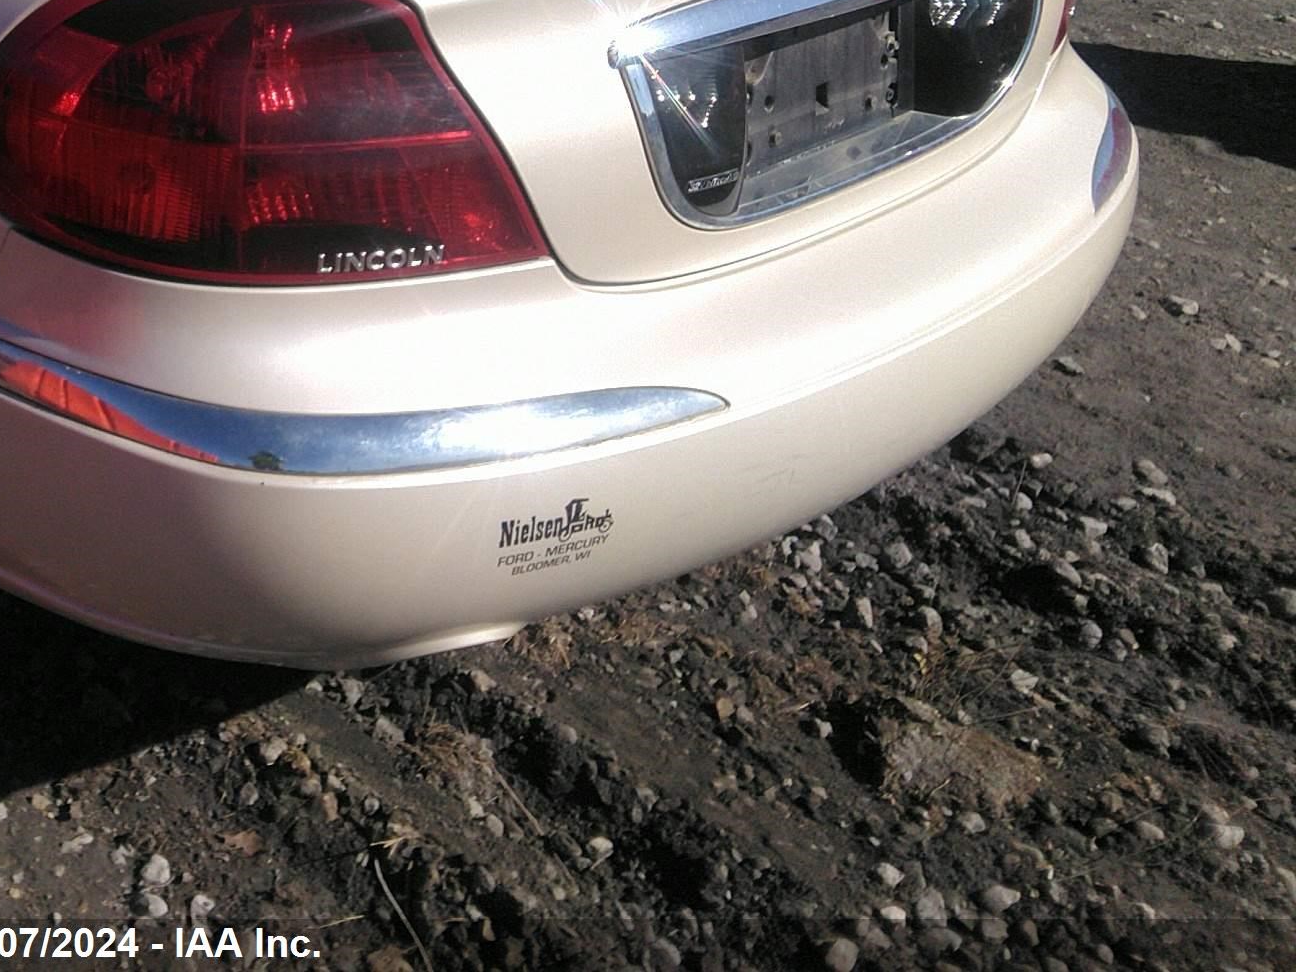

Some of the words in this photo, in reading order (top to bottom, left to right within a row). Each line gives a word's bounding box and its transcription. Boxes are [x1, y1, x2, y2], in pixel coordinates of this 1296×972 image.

[317, 244, 445, 274] LINCOLN
[499, 515, 564, 548] Nielsen
[497, 551, 534, 567] FORD
[544, 534, 610, 558] MERCURY
[575, 550, 592, 563] WI
